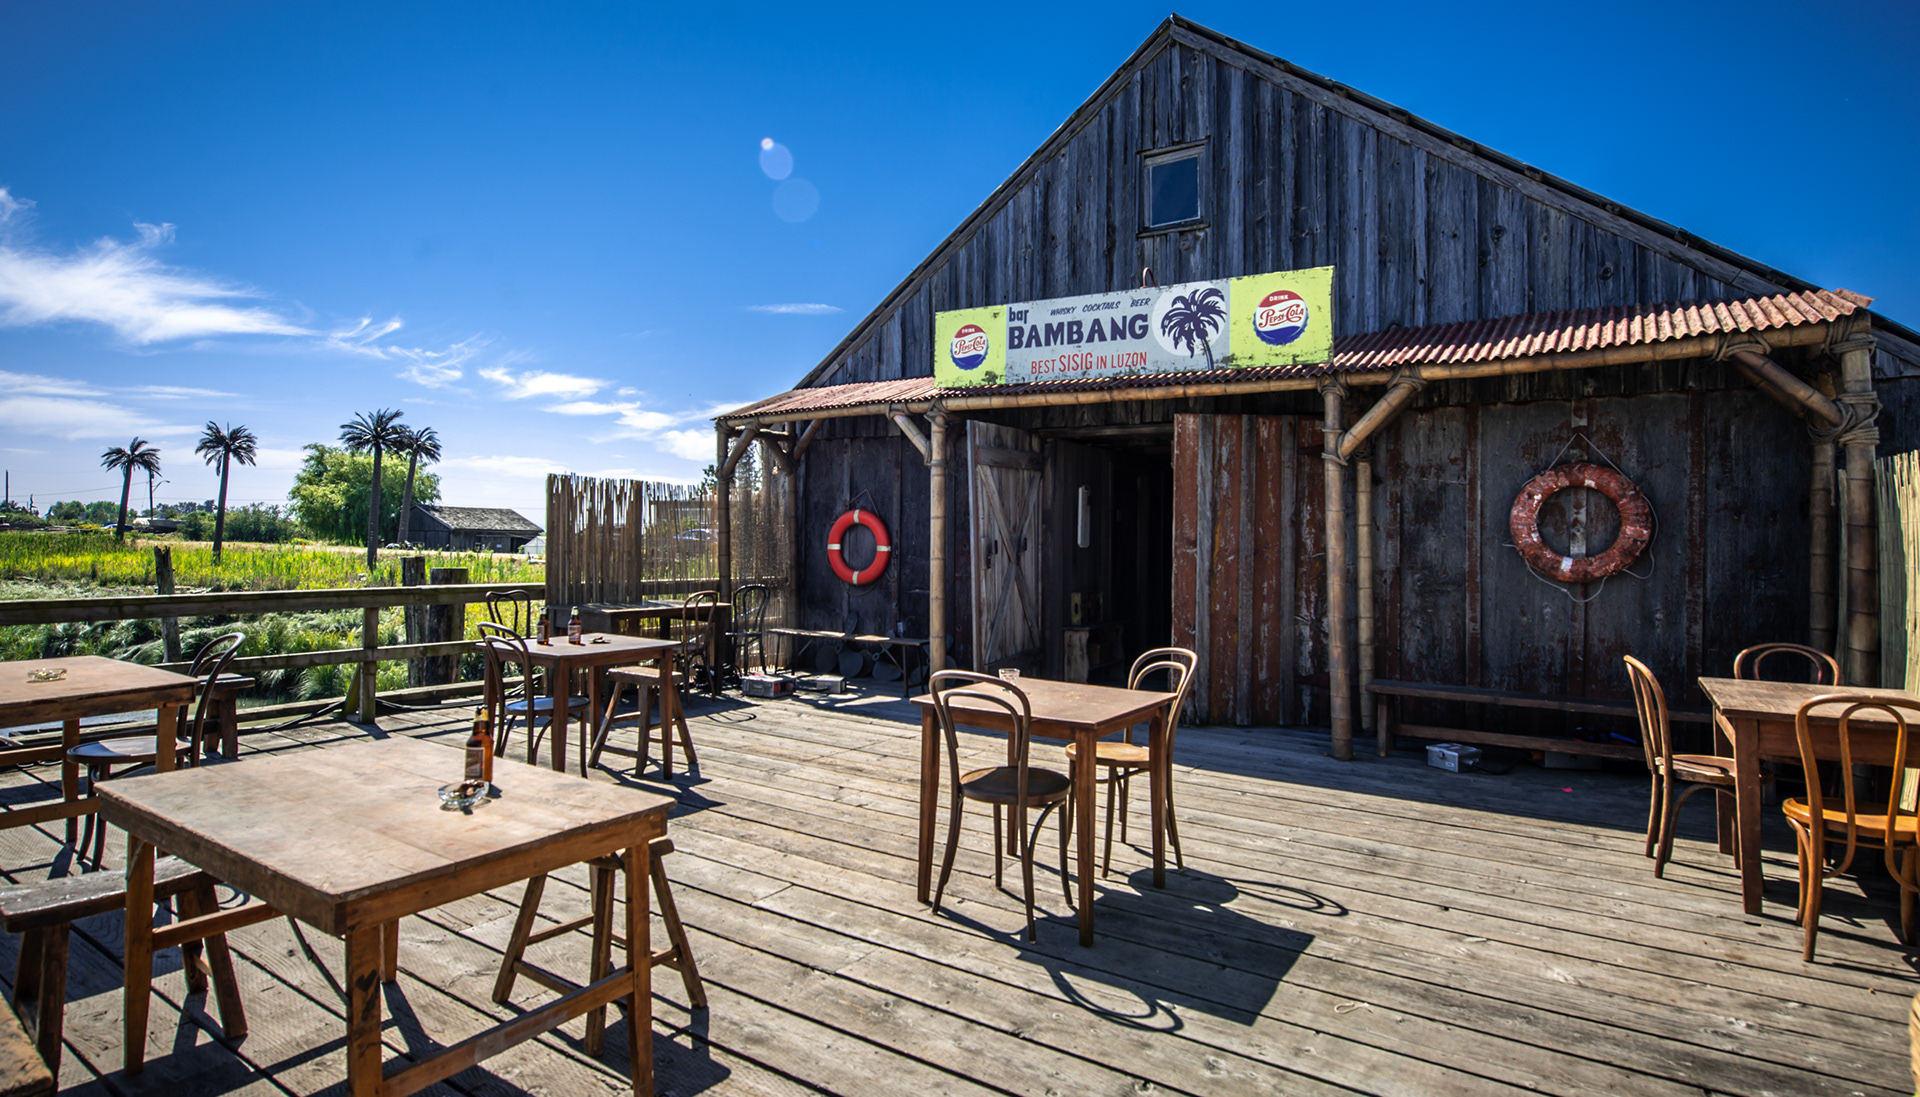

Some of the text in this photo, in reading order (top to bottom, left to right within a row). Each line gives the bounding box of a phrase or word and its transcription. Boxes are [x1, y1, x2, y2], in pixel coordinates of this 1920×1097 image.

[1009, 307, 1029, 324] bar
[1050, 298, 1151, 316] WHISKY COCKTAILS BEER
[1009, 313, 1149, 350] BAMBANG
[1031, 351, 1147, 375] BEST SISIG IN LUZON
